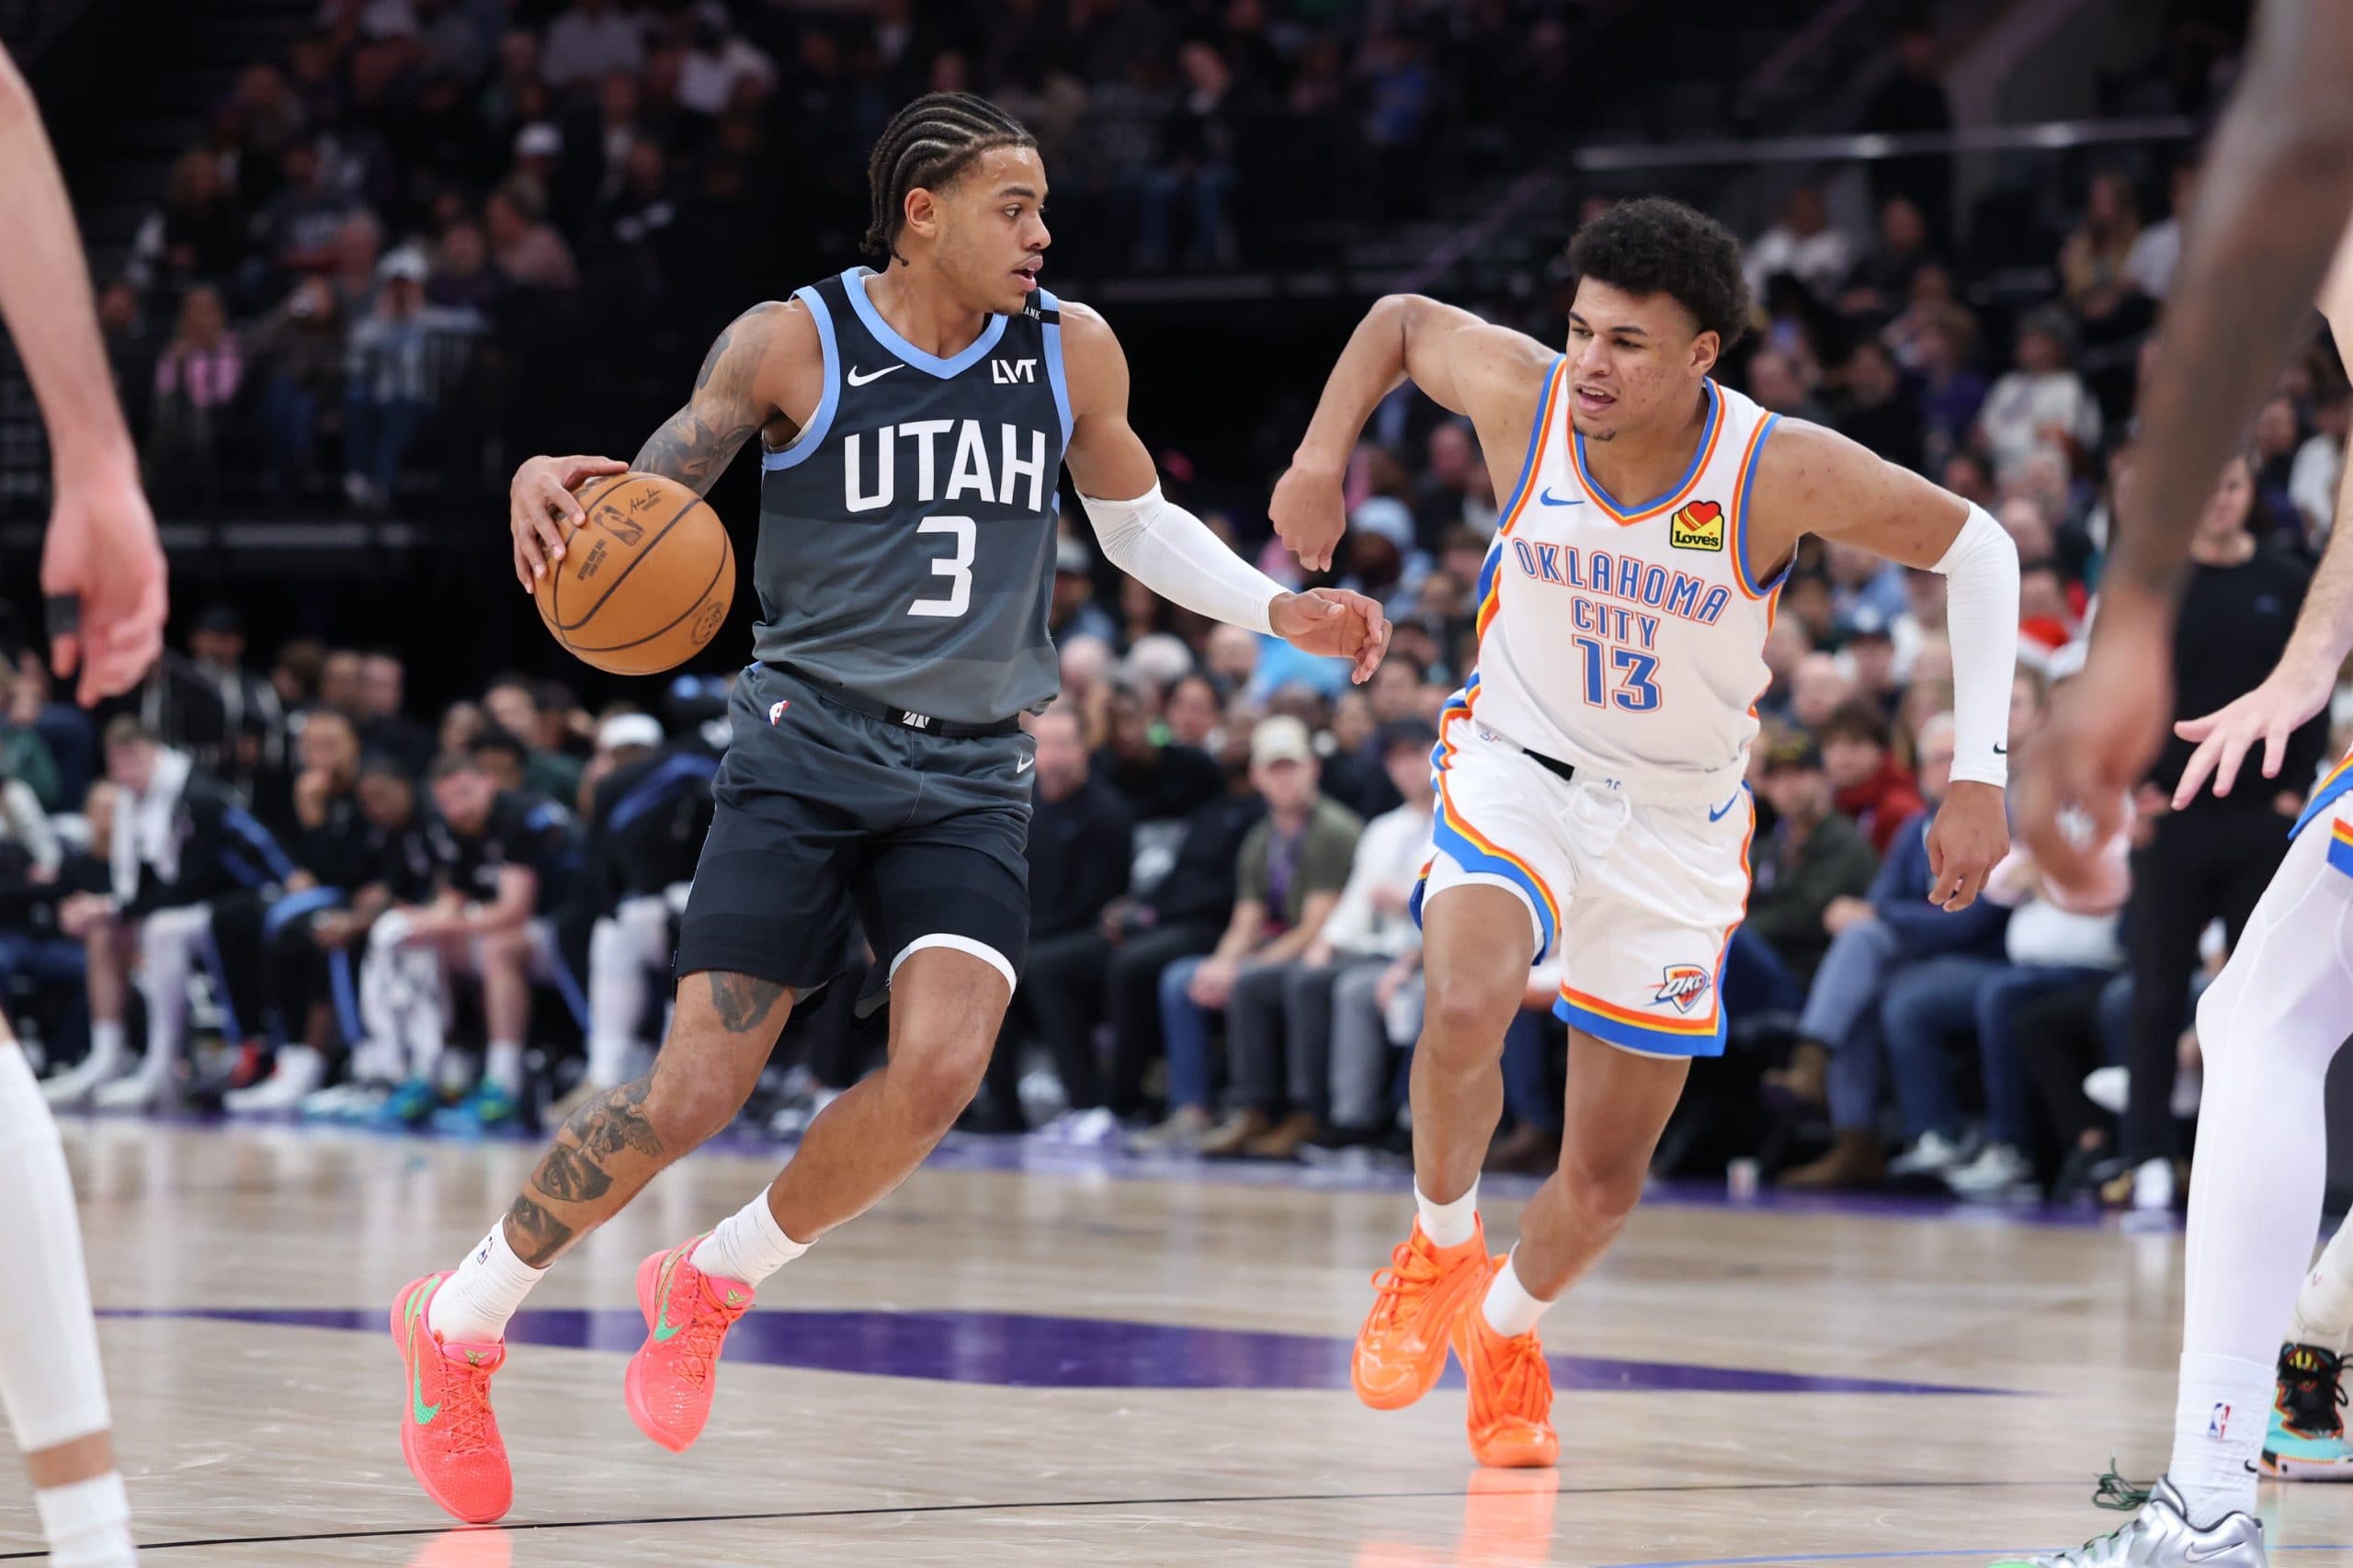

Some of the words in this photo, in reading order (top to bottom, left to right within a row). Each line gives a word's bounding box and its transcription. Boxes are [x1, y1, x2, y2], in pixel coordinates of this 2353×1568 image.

[1021, 306, 1040, 321] ANK
[993, 359, 1037, 384] LVT
[845, 420, 1046, 513] UTAH
[908, 517, 976, 617] 3
[1514, 538, 1732, 626] OKLAHOMA
[1572, 597, 1660, 650] CITY
[1573, 635, 1662, 711] 13
